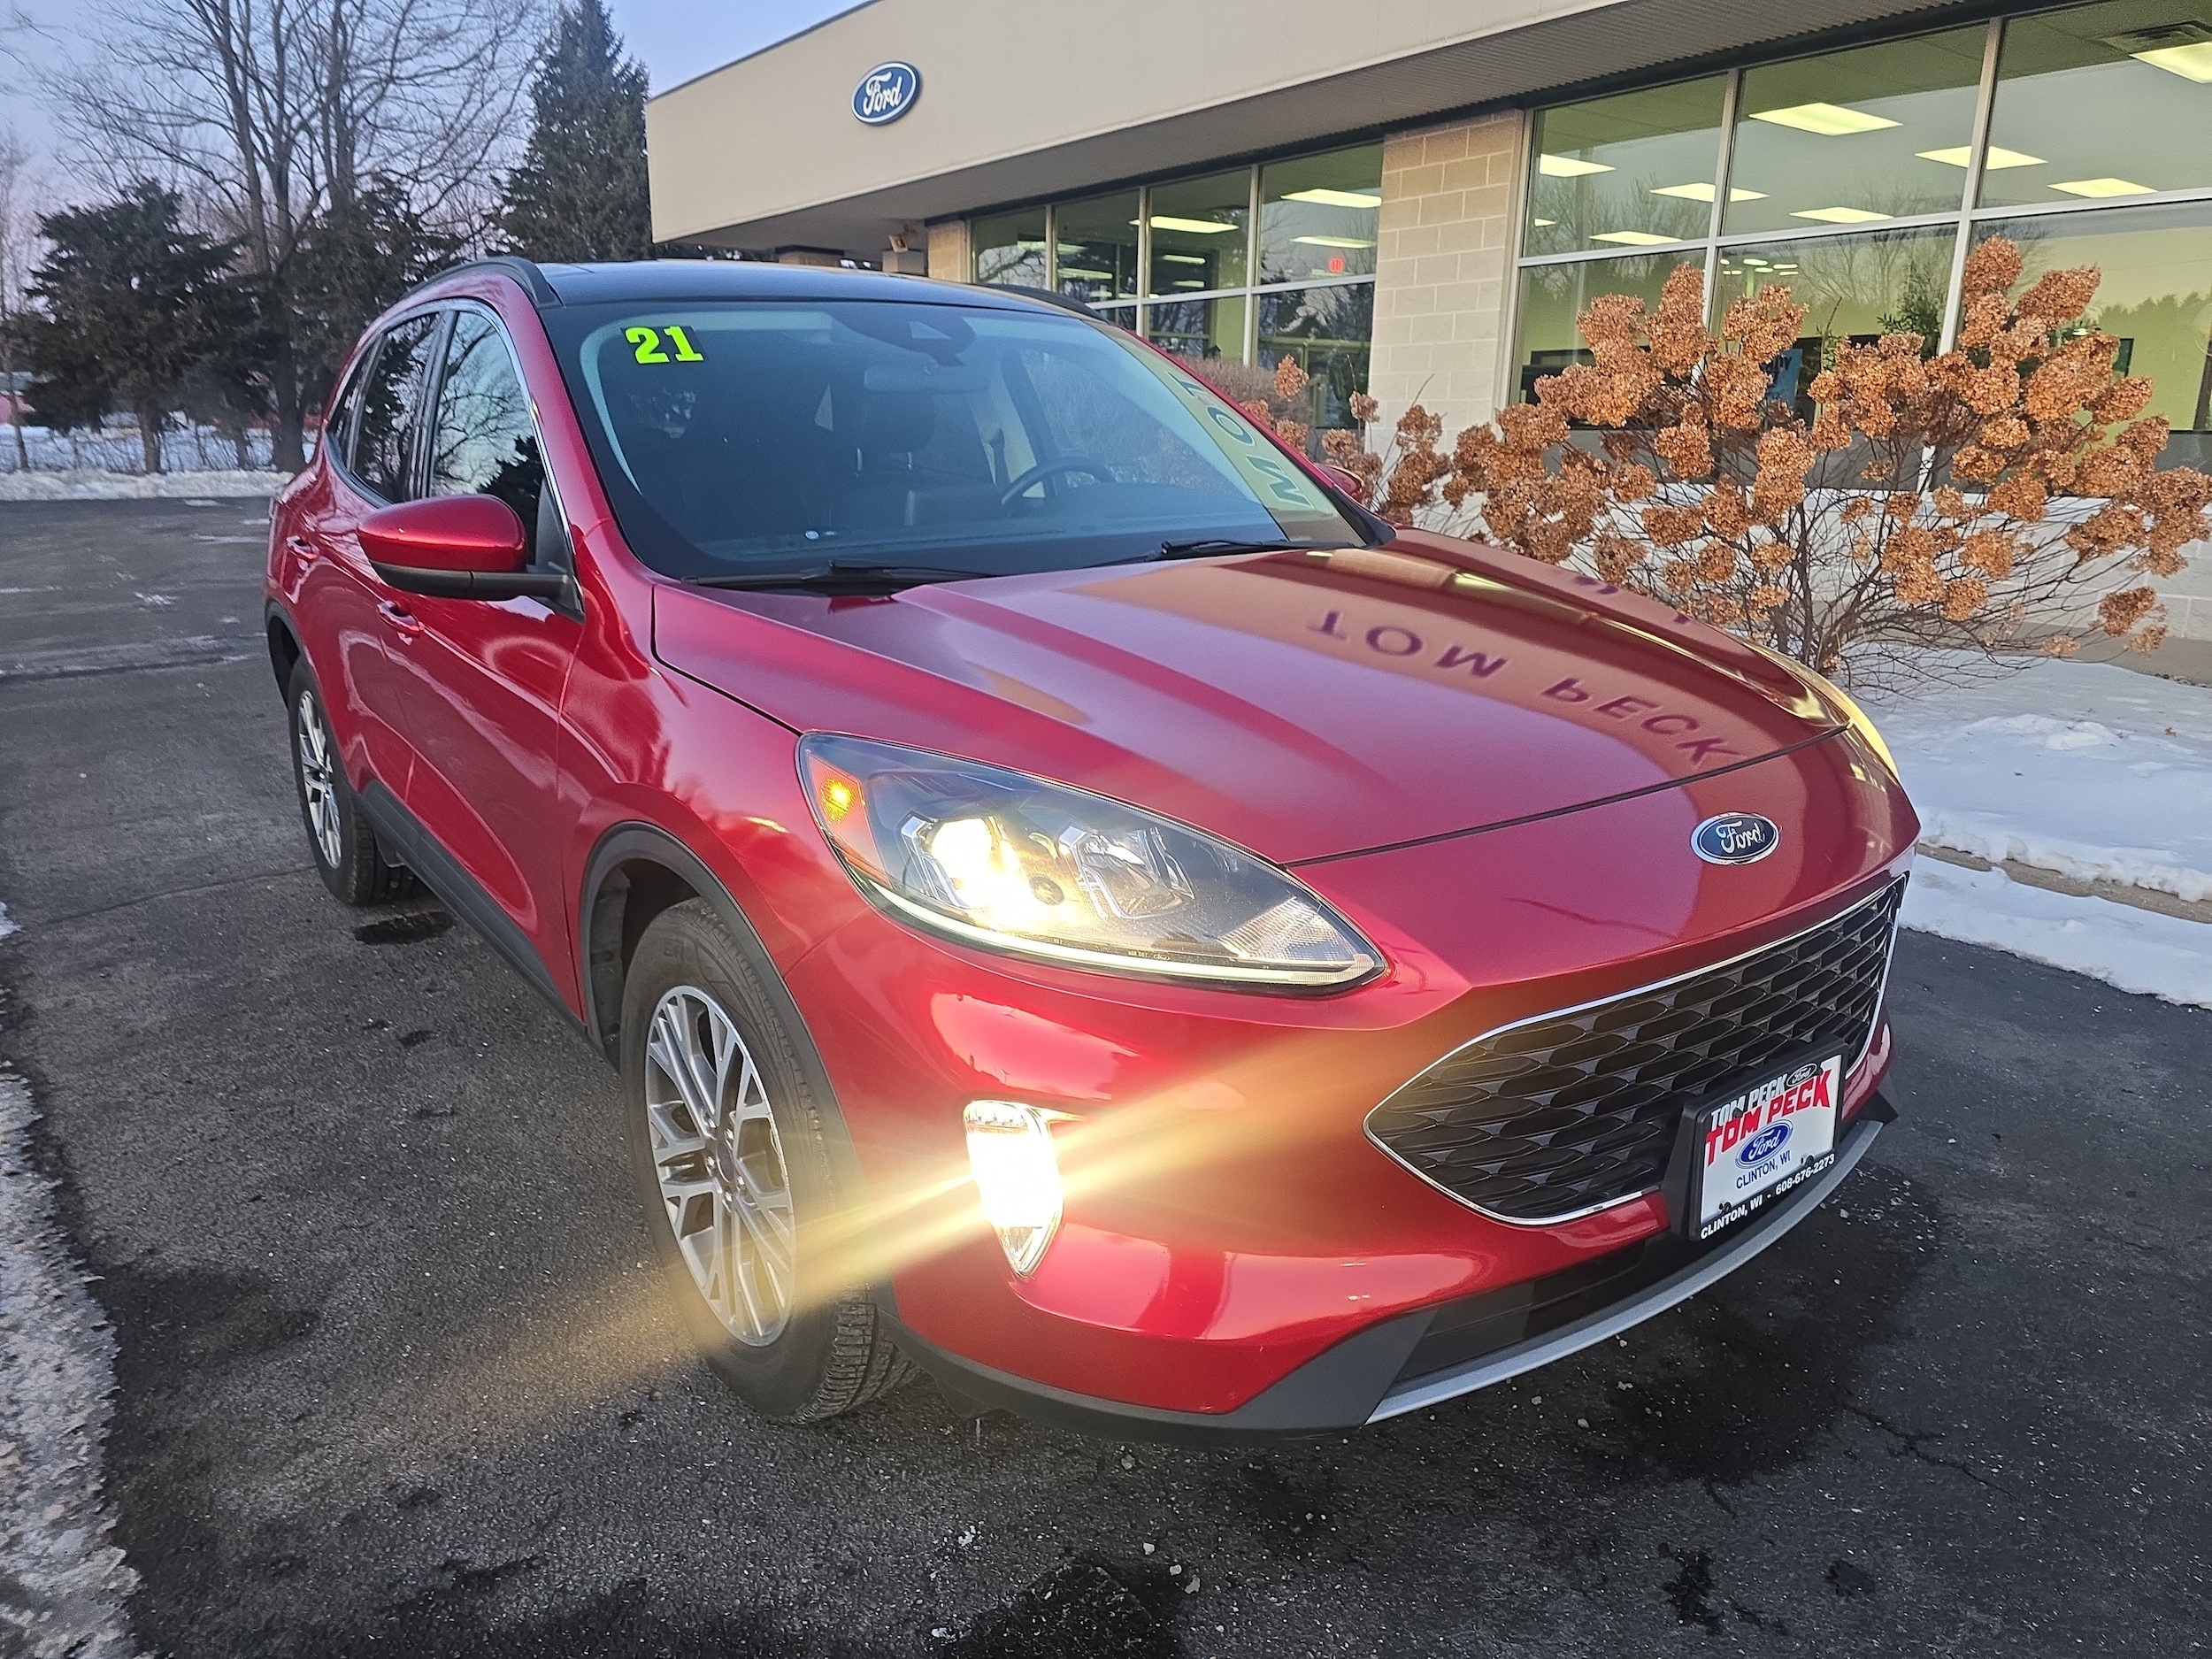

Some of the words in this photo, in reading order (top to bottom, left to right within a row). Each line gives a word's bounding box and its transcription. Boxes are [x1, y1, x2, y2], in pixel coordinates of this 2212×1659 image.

[863, 72, 902, 116] Ford
[625, 326, 704, 364] 21
[1716, 820, 1765, 853] Ford
[1706, 1105, 1763, 1167] TOM
[1767, 1069, 1832, 1124] PECK
[1711, 1095, 1746, 1131] TOM
[1747, 1073, 1788, 1110] PECK
[1792, 1067, 1812, 1084] Ford
[1747, 1129, 1781, 1160] Ford
[1736, 1159, 1778, 1189] CLINTON,
[1780, 1150, 1791, 1165] WI
[1701, 1206, 1748, 1240] CLINTON,
[1749, 1194, 1763, 1210] WI
[1775, 1153, 1835, 1195] 608-676-2273
